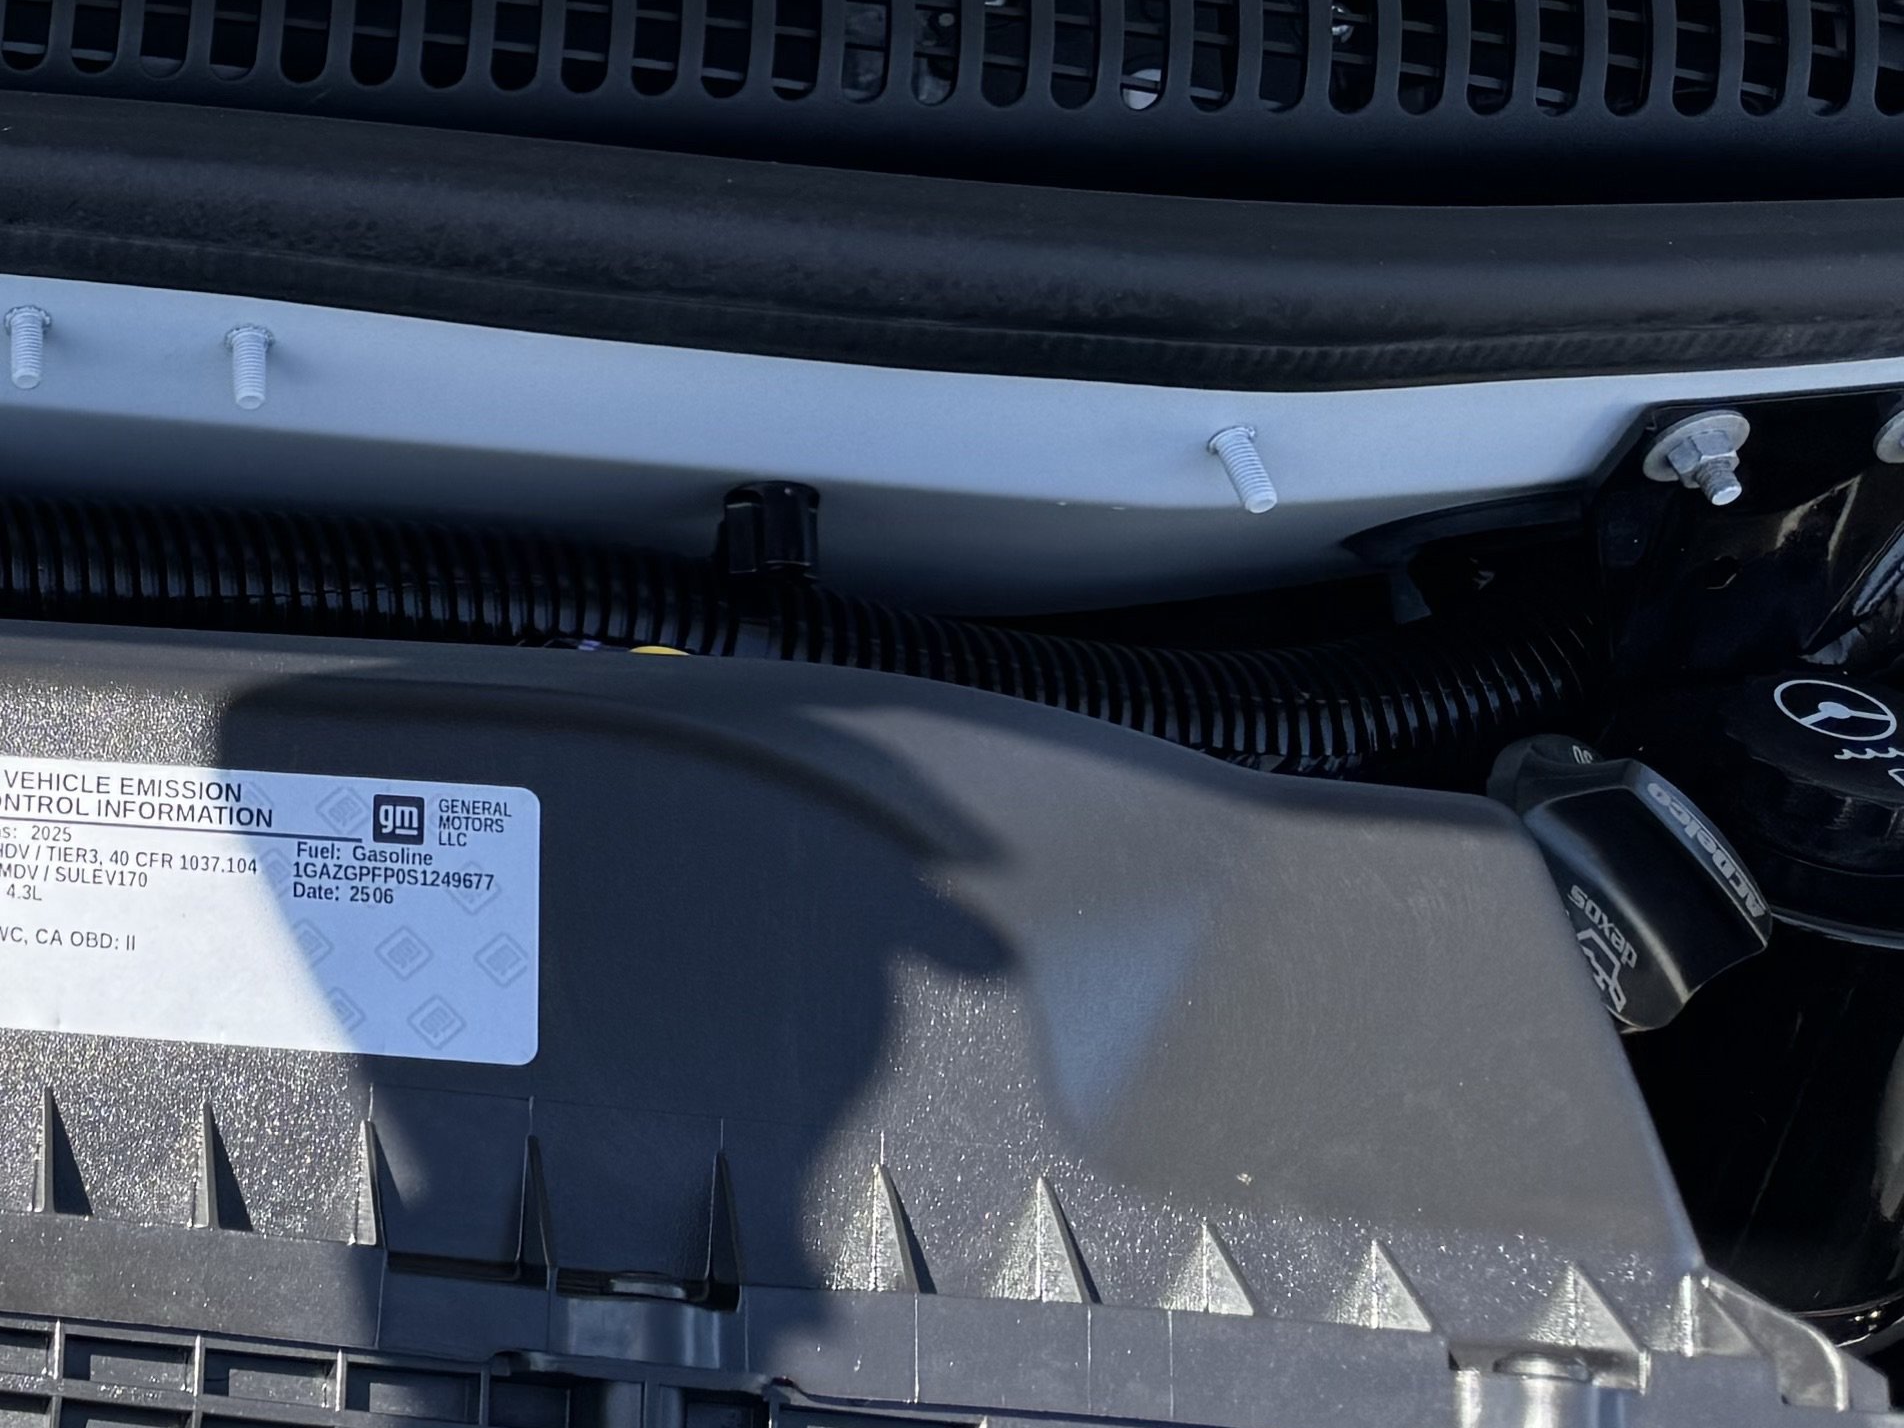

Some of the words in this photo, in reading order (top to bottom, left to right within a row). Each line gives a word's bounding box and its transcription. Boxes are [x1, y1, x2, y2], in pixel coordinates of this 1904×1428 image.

[4, 770, 111, 795] VEHICLE
[121, 776, 242, 803] EMISSION
[97, 799, 273, 828] INFORMATION
[439, 798, 512, 818] GENERAL
[379, 804, 419, 837] gm
[439, 815, 505, 834] MOTORS
[30, 824, 72, 843] 2025
[439, 832, 468, 848] LLC
[46, 845, 103, 866] TIER3,
[109, 849, 129, 867] 40
[135, 851, 173, 870] CFR
[179, 855, 258, 875] 1037.104
[297, 841, 341, 861] Fuel:
[352, 845, 433, 866] Gasoline
[1647, 783, 1766, 917] ACDelco
[55, 865, 148, 888] SULEV170
[293, 861, 495, 891] 1GAZGPFP0S1249677
[6, 884, 42, 901] 4.3L
[293, 881, 340, 901] Date:
[1568, 885, 1637, 968] dexos
[35, 928, 63, 947] CA
[70, 931, 119, 951] OBD:
[125, 934, 136, 951] II
